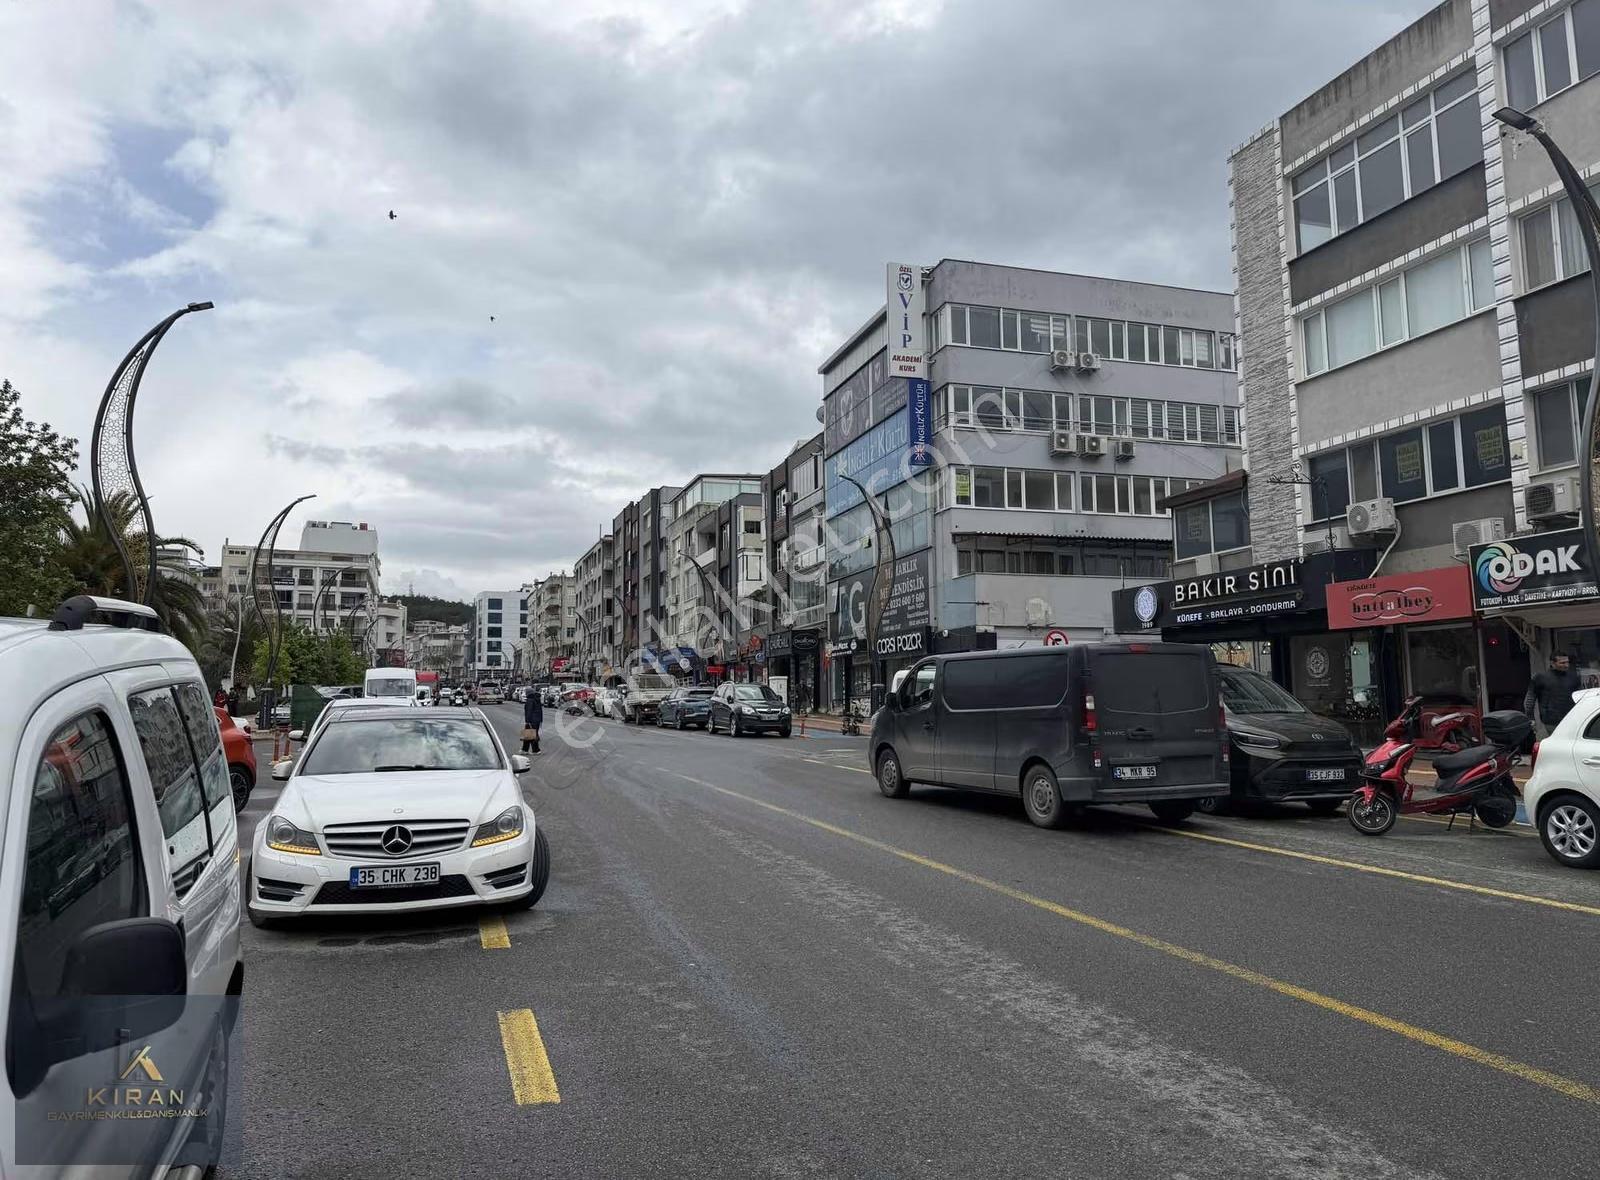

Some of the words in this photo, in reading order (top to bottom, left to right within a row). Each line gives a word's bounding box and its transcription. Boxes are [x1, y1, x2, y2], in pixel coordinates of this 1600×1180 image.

[892, 354, 922, 363] AKADEMİ
[898, 364, 916, 373] KURS
[1488, 544, 1582, 581] ODAK
[1175, 575, 1238, 602] BAKIR
[1176, 612, 1203, 624] KÜNEFE
[1210, 607, 1244, 619] BAKLAVA
[1250, 600, 1296, 614] DONDURMA
[1117, 768, 1126, 777] 34
[1130, 767, 1143, 777] MKR
[1146, 766, 1155, 776] 95
[359, 870, 375, 884] 35
[382, 868, 406, 883] CHK
[414, 866, 437, 881] 238
